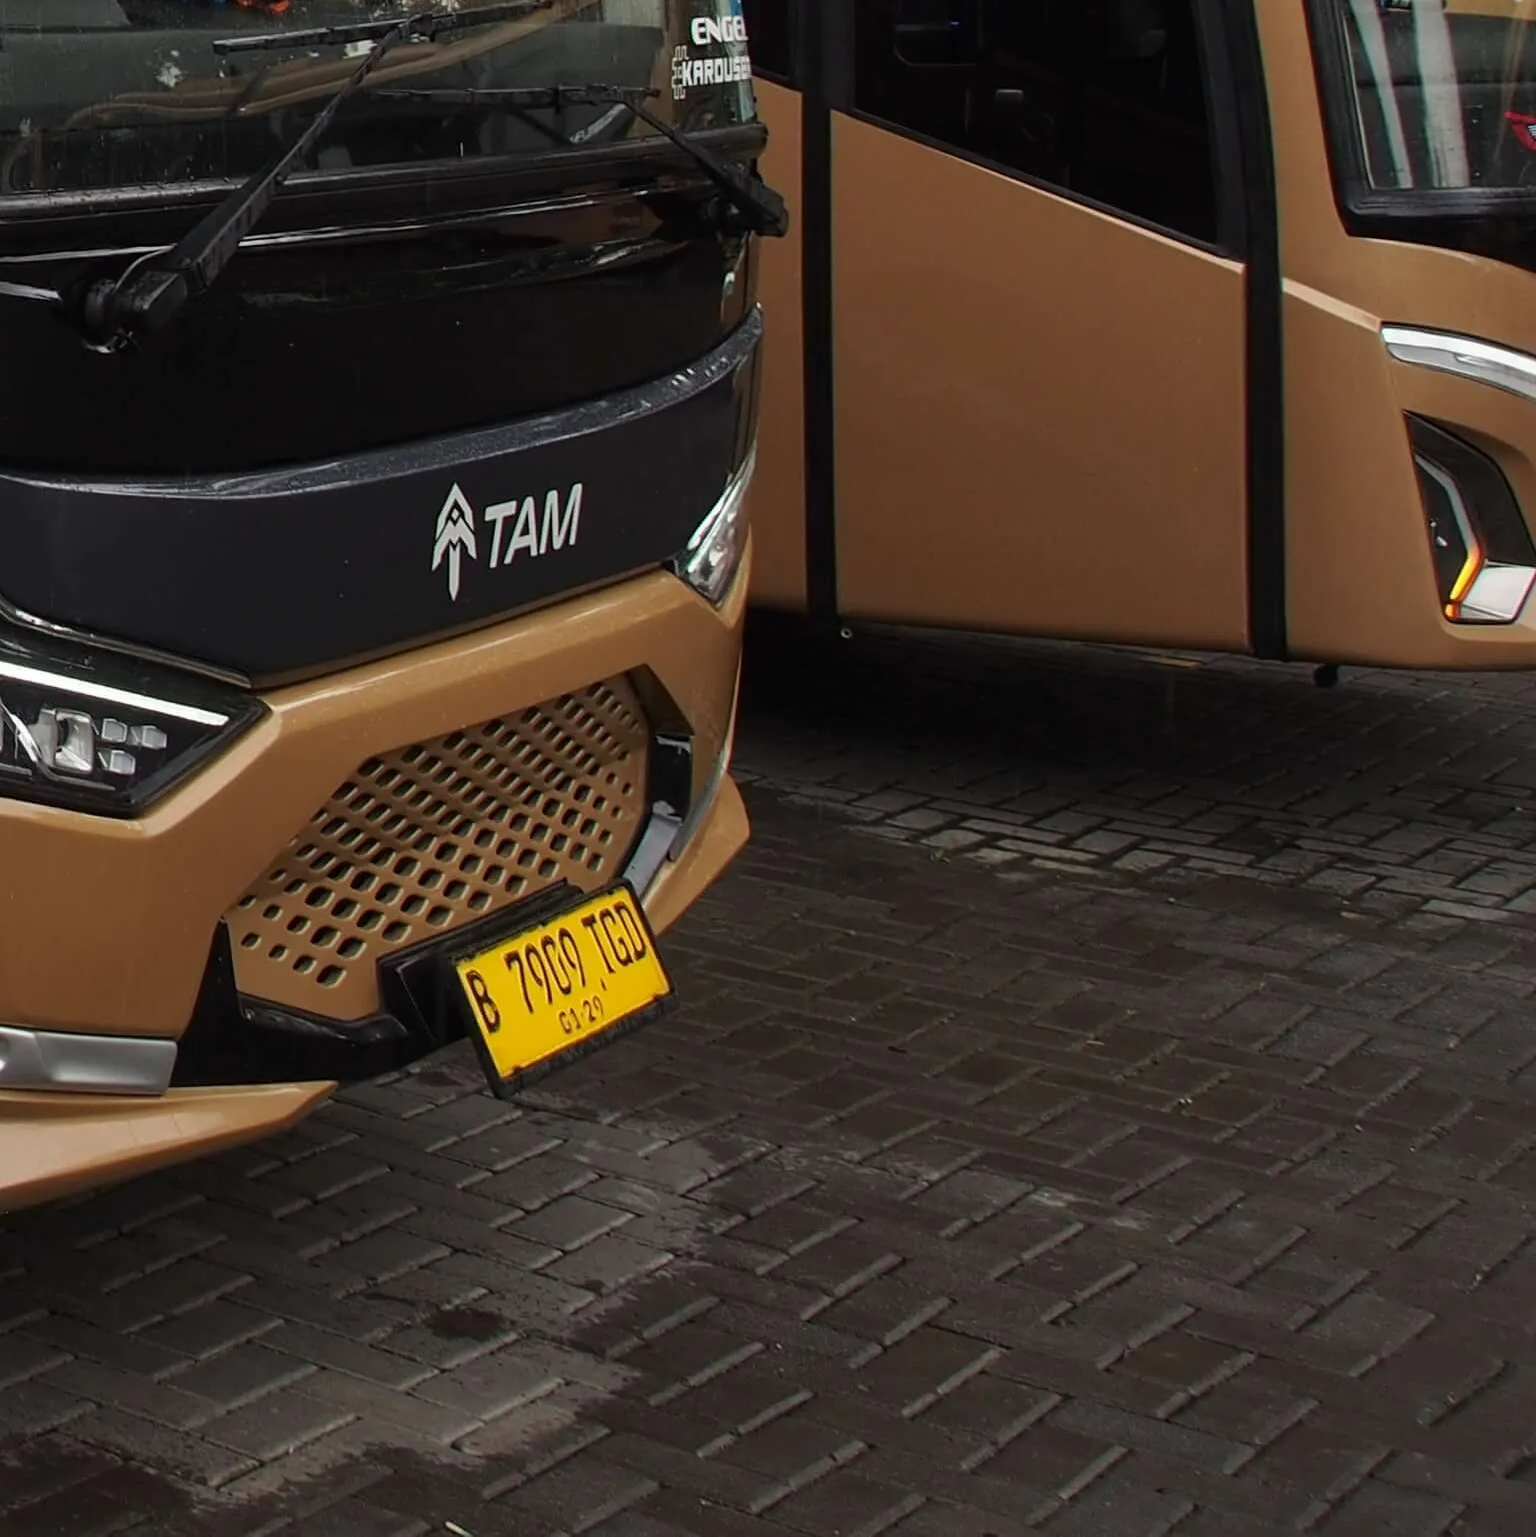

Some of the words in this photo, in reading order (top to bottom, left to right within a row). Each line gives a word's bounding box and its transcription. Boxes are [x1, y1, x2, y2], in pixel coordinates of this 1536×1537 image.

[484, 483, 584, 569] TAM
[466, 969, 501, 1034] B
[504, 927, 587, 1014] 7909
[581, 901, 647, 974] TGD
